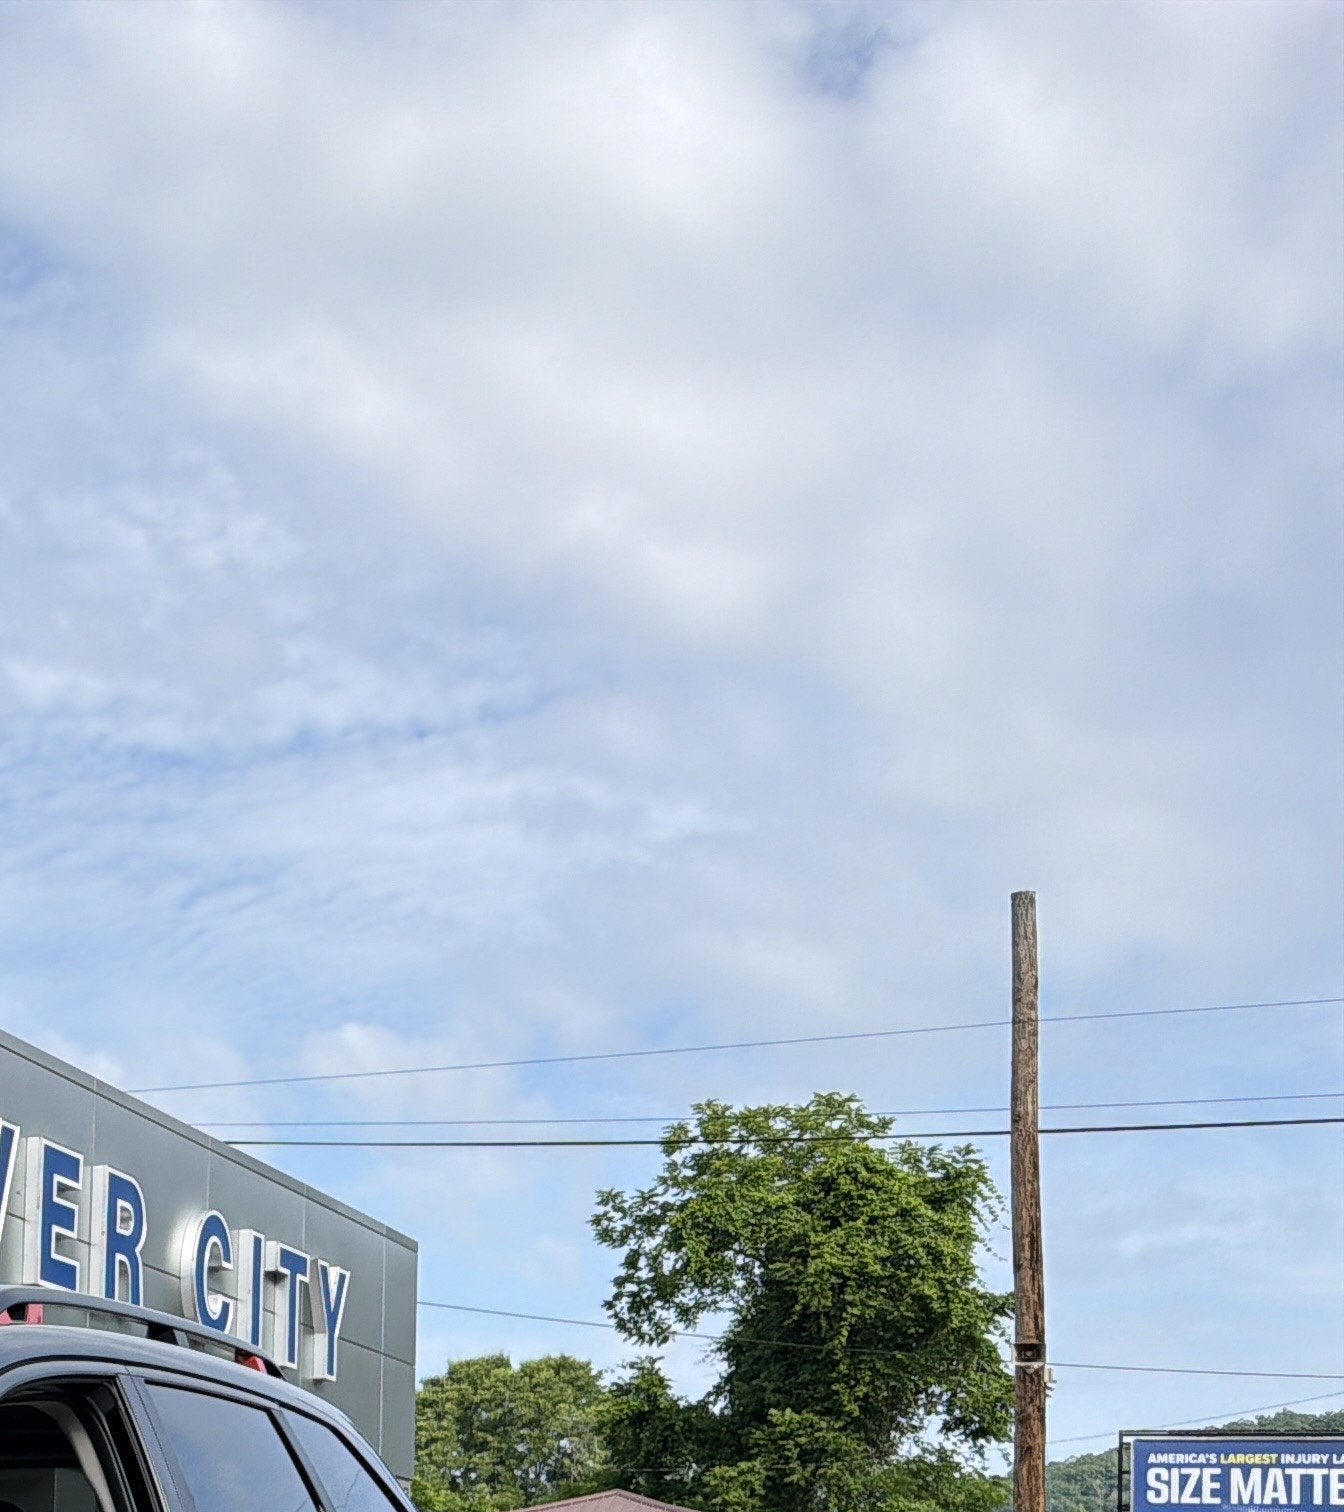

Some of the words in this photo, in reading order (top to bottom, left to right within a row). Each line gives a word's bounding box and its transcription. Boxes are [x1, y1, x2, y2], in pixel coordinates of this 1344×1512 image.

[182, 1210, 352, 1381] CITY
[1147, 1453, 1217, 1464] AMERICA'S
[1220, 1453, 1278, 1465] LARGEST
[1280, 1453, 1330, 1465] INJURY
[1146, 1467, 1222, 1504] SIZE
[1230, 1467, 1344, 1506] MATTE
